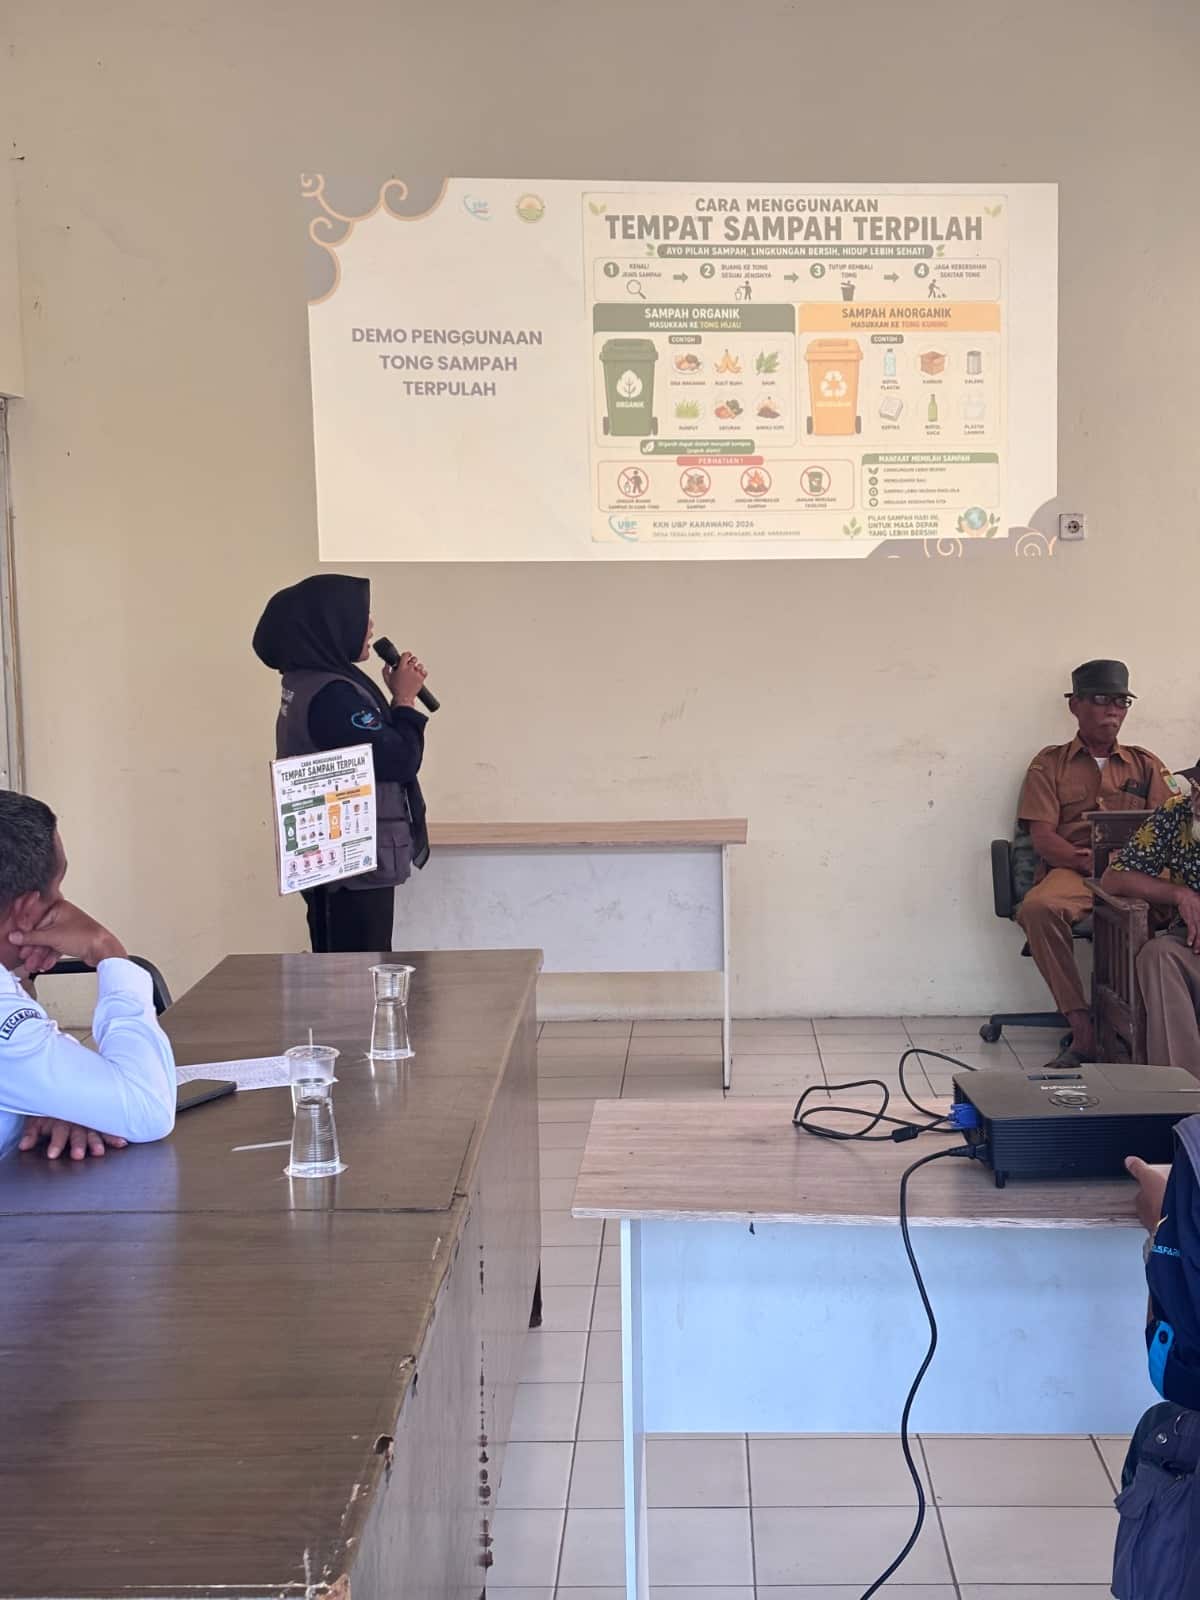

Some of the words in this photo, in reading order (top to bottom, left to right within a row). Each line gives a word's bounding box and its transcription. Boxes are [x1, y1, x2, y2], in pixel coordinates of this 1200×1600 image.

[695, 198, 740, 212] CARA
[746, 199, 879, 212] MENGGUNAKAN
[605, 214, 713, 240] TEMPAT
[724, 215, 842, 241] SAMPAH
[853, 216, 982, 241] TERPILAH
[666, 247, 682, 255] AYO
[685, 247, 710, 255] PILAH
[751, 247, 807, 256] LINGKUNGAN
[843, 247, 868, 256] HIDUP
[870, 247, 895, 256] LEBIH
[897, 247, 925, 256] SEHAT!
[644, 308, 689, 319] SAMPAH
[691, 308, 740, 319] ORGANIK
[841, 308, 886, 319] SAMPAH
[889, 308, 952, 319] ANORGANIK
[649, 321, 688, 329] MASUKKAN
[689, 321, 698, 329] KE
[352, 328, 407, 343] DEMO
[411, 329, 543, 345] PENGGUNAAN
[379, 355, 433, 370] TONG
[438, 356, 518, 371] SAMPAH
[403, 381, 496, 396] TERPULAH
[652, 521, 670, 529] KKN
[689, 520, 734, 529] KARAWANG
[281, 768, 306, 782] TEMPAT
[307, 762, 335, 776] SAMPAH
[337, 756, 366, 769] TERPILAH
